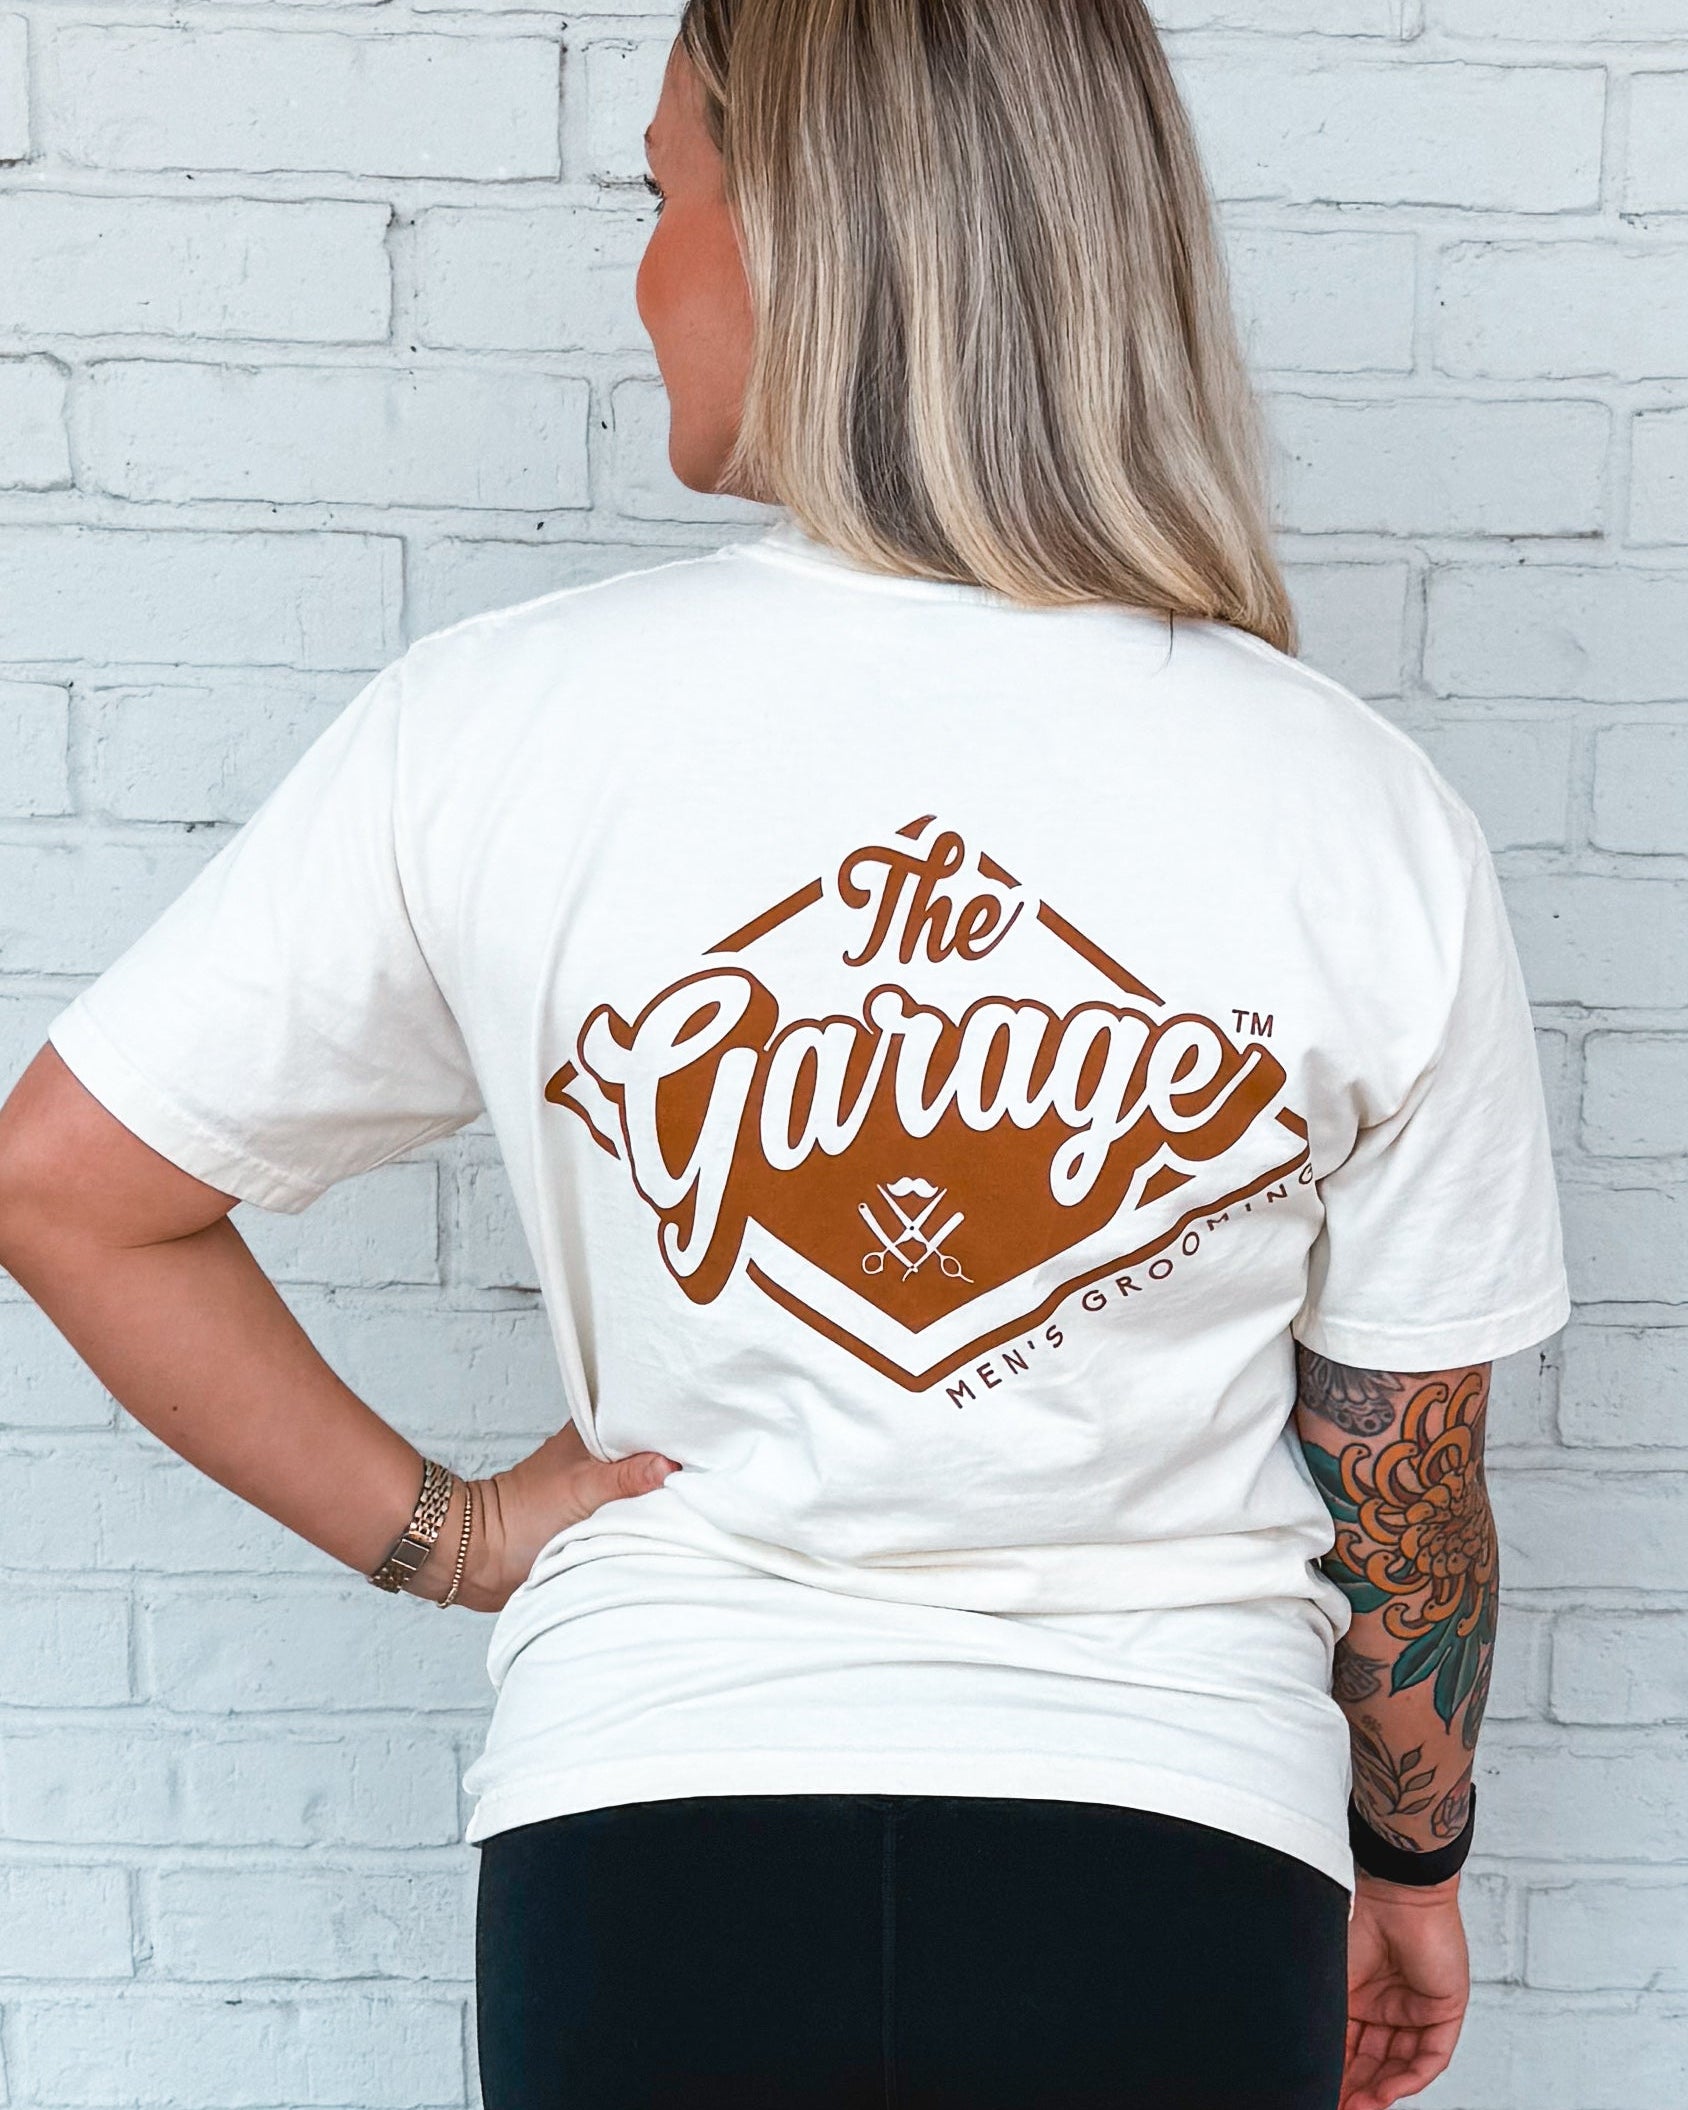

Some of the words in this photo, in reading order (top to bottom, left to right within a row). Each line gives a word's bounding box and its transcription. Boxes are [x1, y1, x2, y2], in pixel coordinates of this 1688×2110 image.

[836, 830, 1024, 967] The
[576, 966, 1266, 1284] Garage
[1231, 1009, 1274, 1038] TM
[945, 1324, 1064, 1409] MEN'S
[1081, 1162, 1314, 1312] GROOMING
